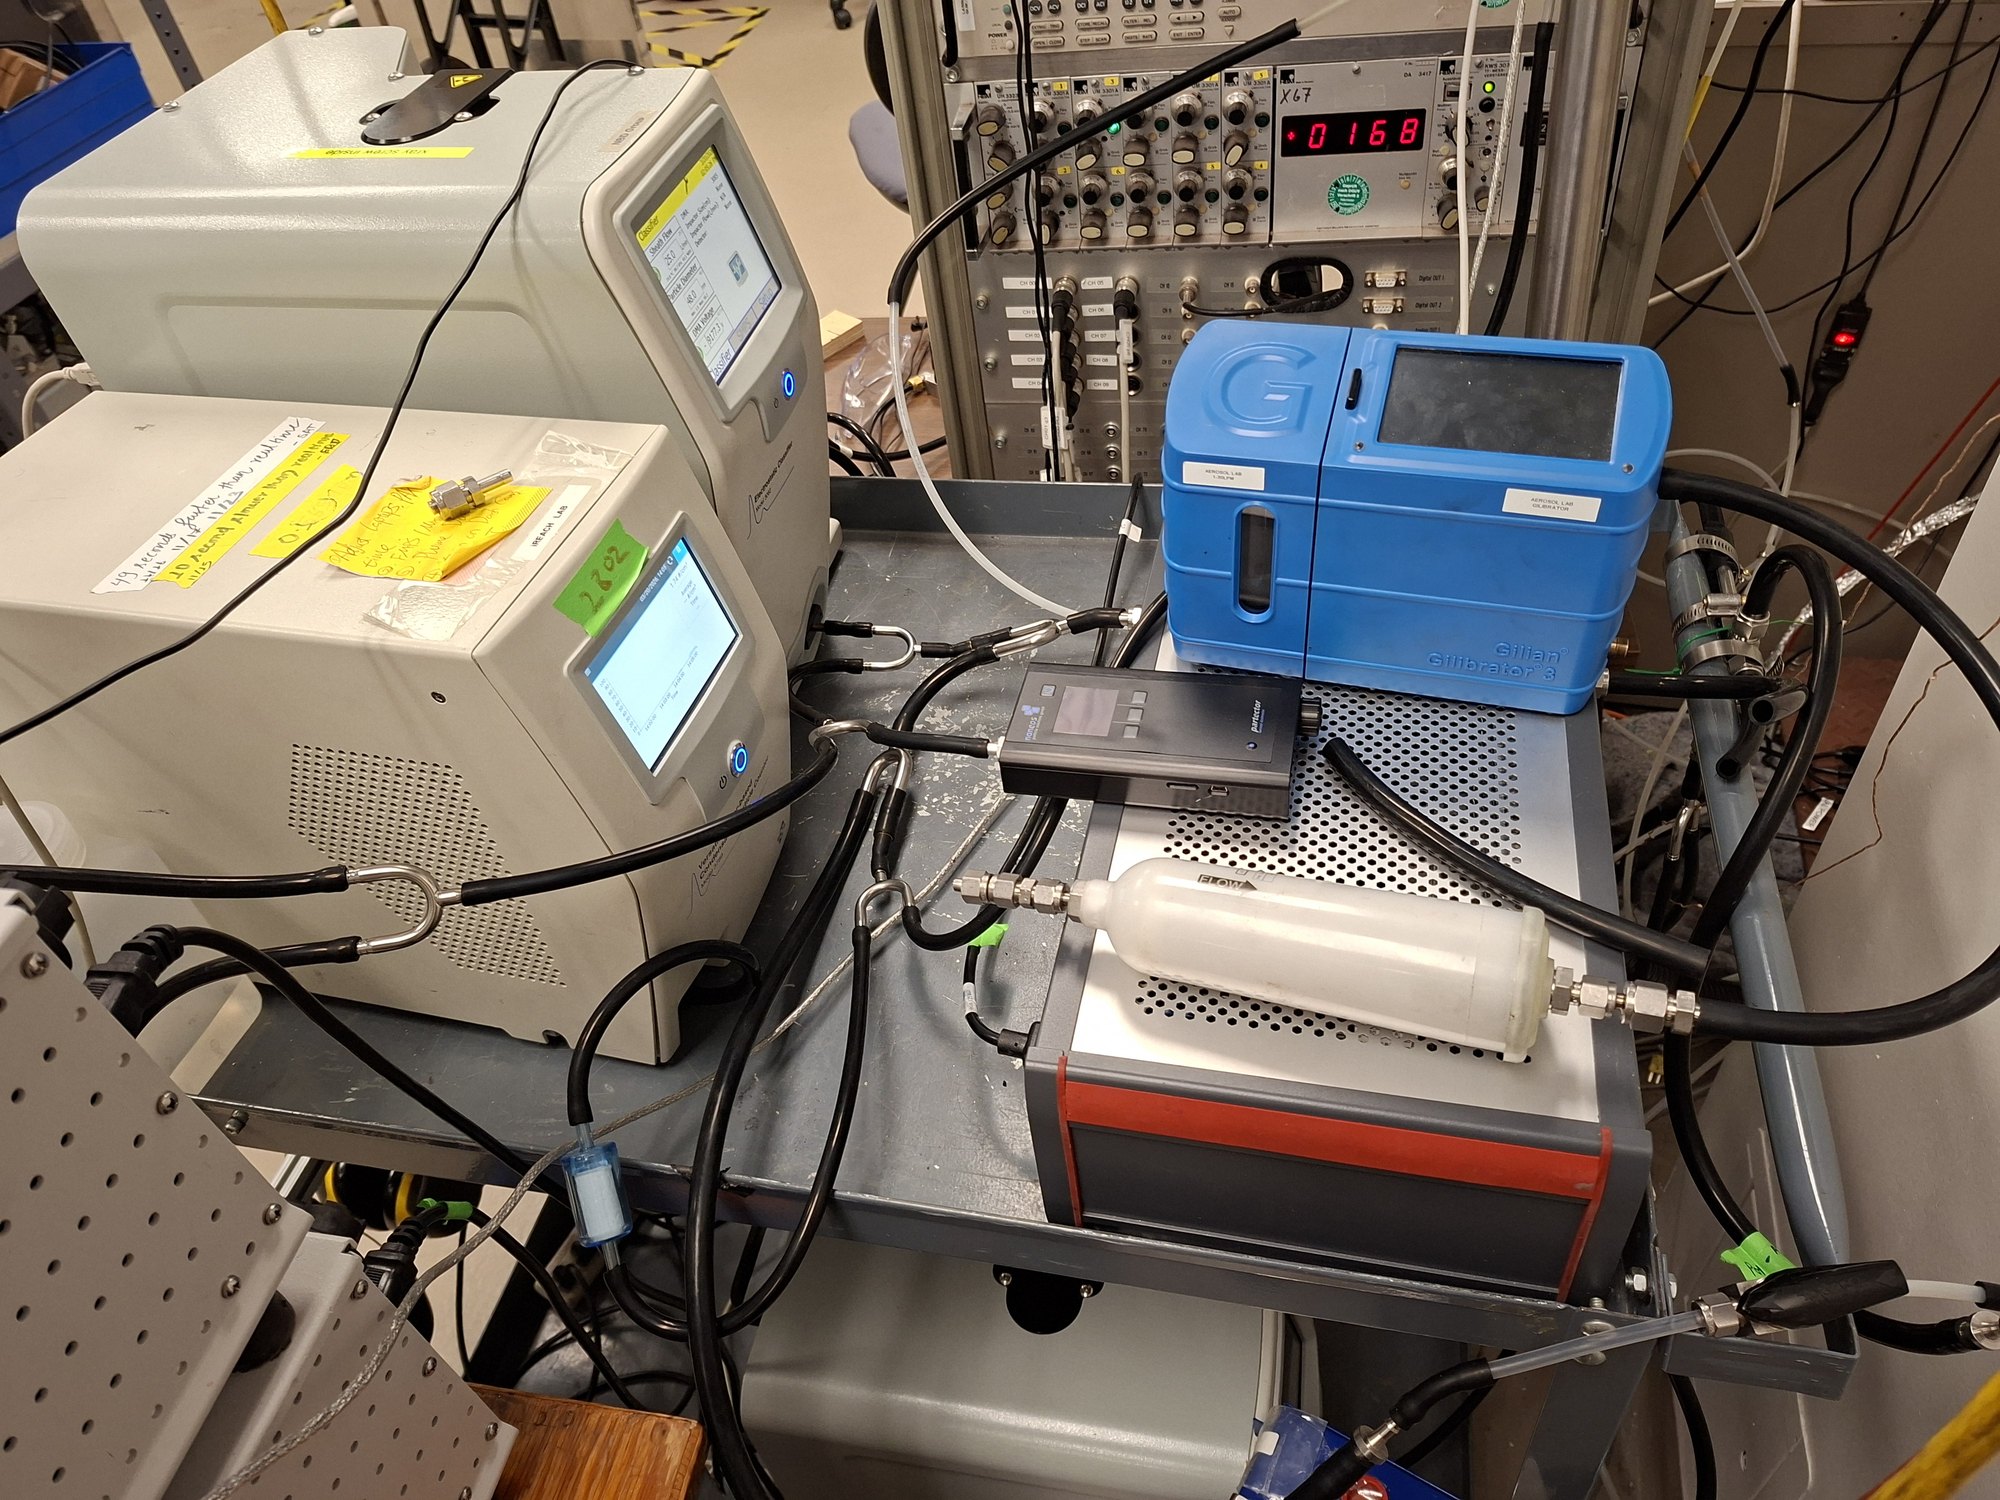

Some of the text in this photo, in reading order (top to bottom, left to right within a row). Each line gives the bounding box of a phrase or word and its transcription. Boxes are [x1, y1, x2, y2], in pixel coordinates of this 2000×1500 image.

[638, 214, 659, 241] Classifier
[648, 236, 664, 257] Sheath
[680, 262, 697, 286] Diameter
[700, 305, 715, 327] Voltage
[552, 504, 568, 520] LAB
[1531, 497, 1560, 505] AEROSOL
[1495, 642, 1560, 664] Gilian
[1427, 652, 1557, 682] Gilibrator 3
[1251, 700, 1262, 733] partector
[1198, 874, 1243, 890] FLOW
